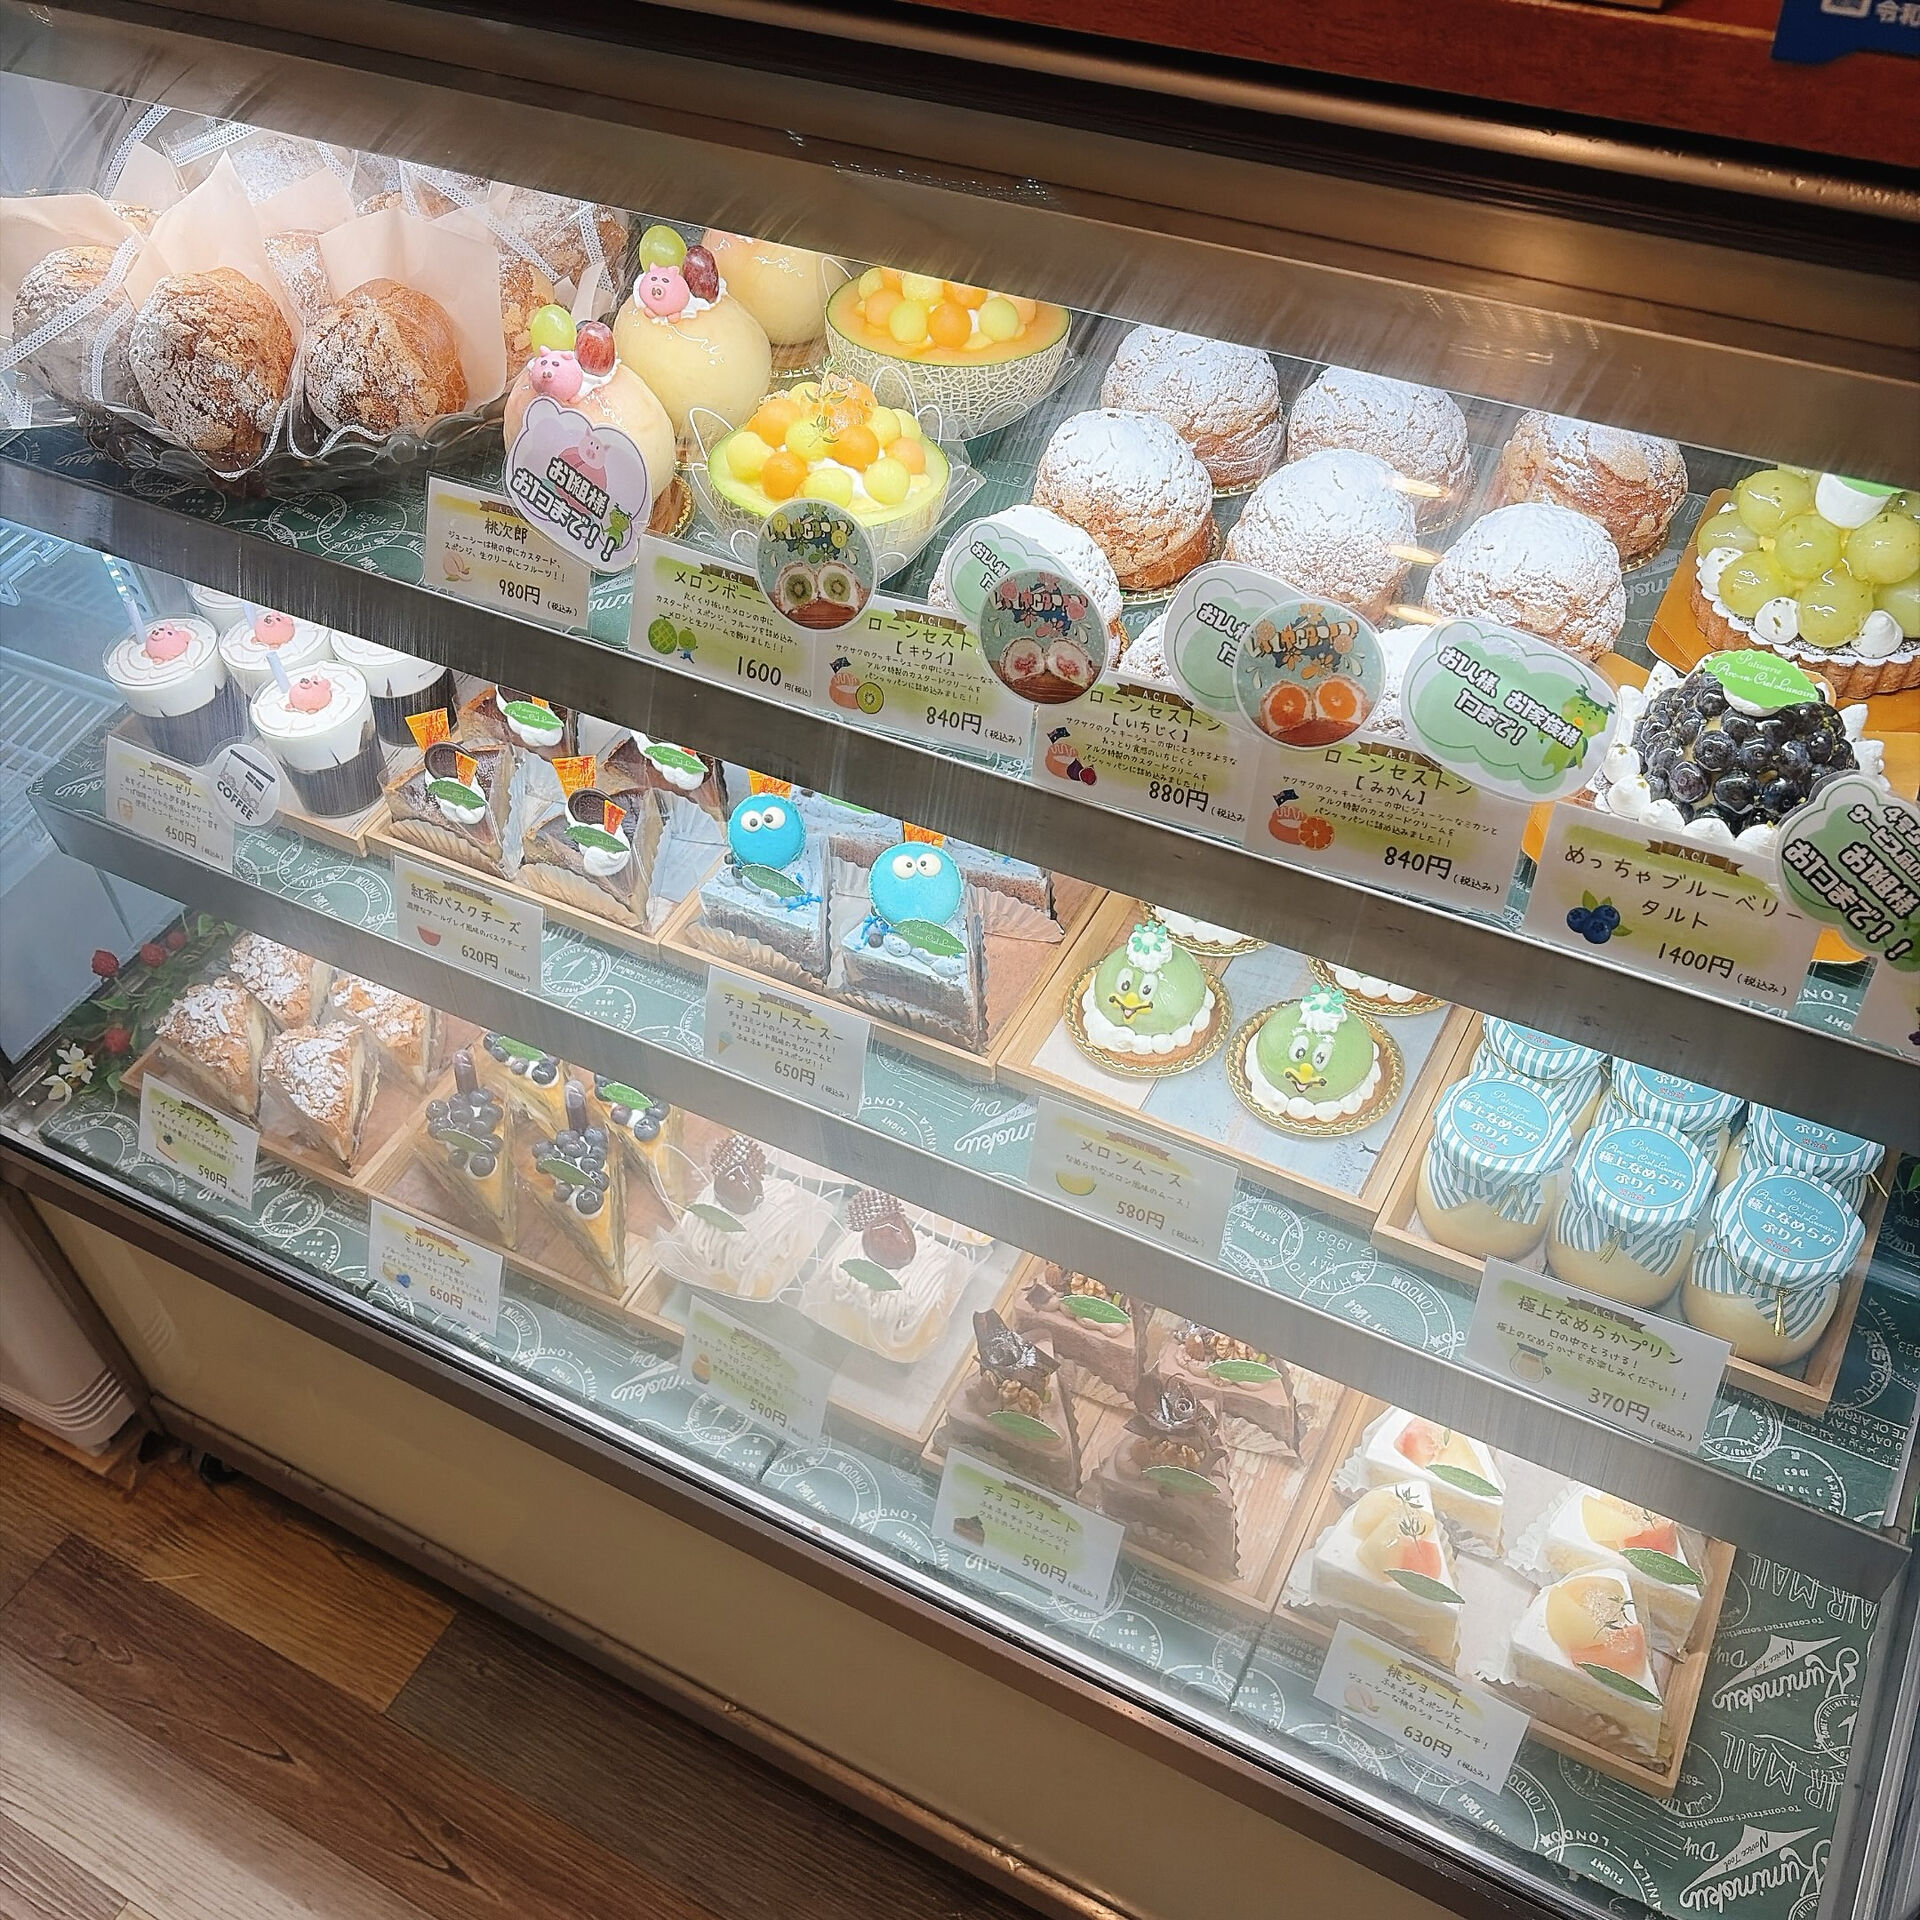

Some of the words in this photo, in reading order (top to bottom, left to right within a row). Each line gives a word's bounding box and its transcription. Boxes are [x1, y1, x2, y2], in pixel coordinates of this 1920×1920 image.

[484, 517, 528, 545] 桃次郎
[499, 579, 541, 605] 980円
[737, 656, 782, 686] 1600
[926, 706, 982, 735] 840円
[1089, 689, 1222, 732] ローンセストン
[138, 767, 203, 799] コーヒーゼリー
[1324, 748, 1473, 796] ローンセストン
[216, 780, 254, 821] COFFEE
[1149, 781, 1209, 812] 880円
[165, 825, 198, 849] 450円
[1384, 846, 1452, 881] 840円
[1564, 845, 1803, 920] めっちゃブルーベリー
[411, 882, 522, 935] 紅茶バスクチーズ
[1641, 899, 1709, 930] タルト
[461, 944, 499, 970] 620円
[1658, 942, 1735, 979] 1400円
[723, 992, 845, 1042] チョコットスースー
[774, 1060, 816, 1087] 650円
[1457, 1098, 1540, 1142] 極上なめらか
[198, 1164, 228, 1189] 590円
[1081, 1139, 1182, 1188] メロンムース
[1599, 1150, 1686, 1191] 極上なめらか
[1115, 1200, 1165, 1231] 580円
[1746, 1196, 1836, 1246] 極上なめらか
[404, 1231, 470, 1268] ミルクレープ
[429, 1285, 464, 1311] 650円
[1517, 1294, 1684, 1365] 極上なめらかプリン
[750, 1399, 788, 1428] 590円
[1587, 1386, 1651, 1422] 370円
[983, 1485, 1077, 1534] チョコショート
[1021, 1554, 1067, 1585] 590円
[1386, 1663, 1465, 1710] 桃ショート
[1403, 1724, 1453, 1759] 630円
